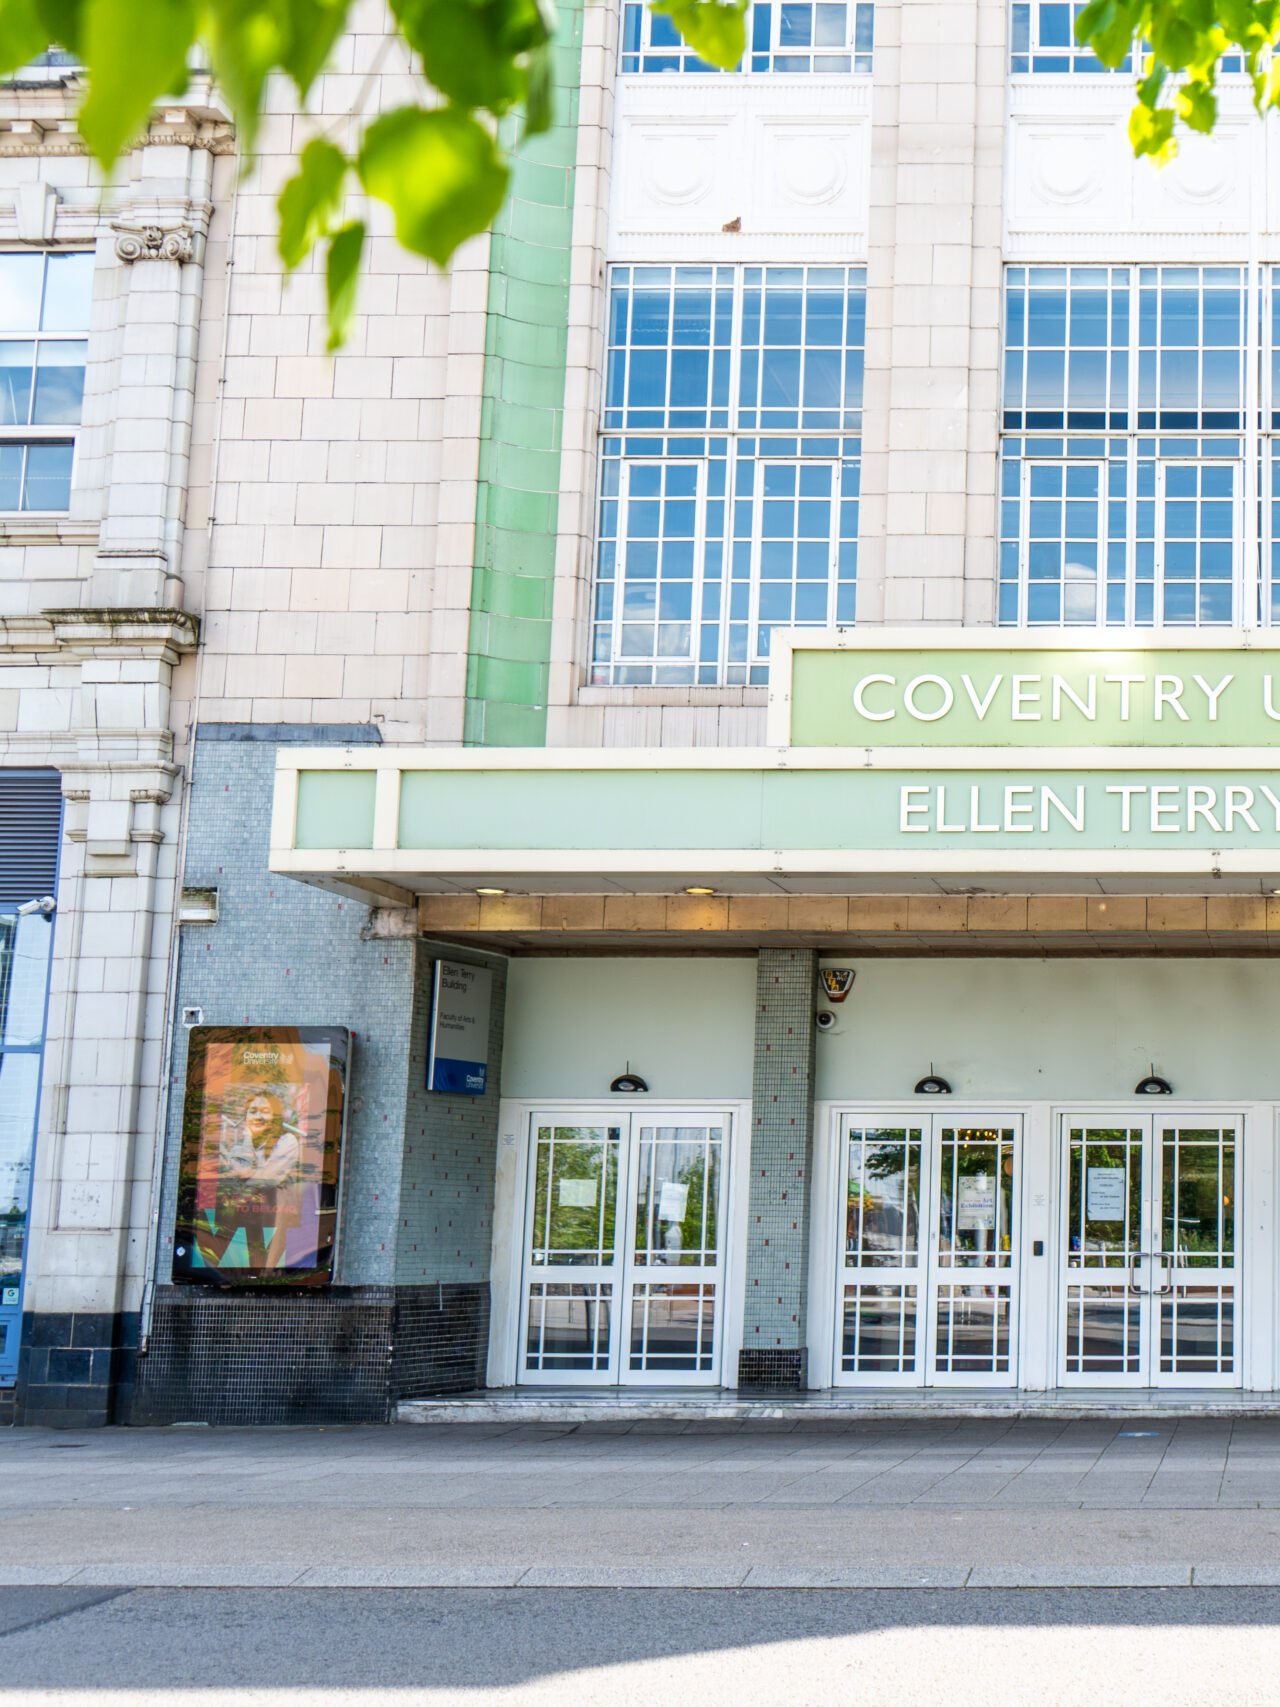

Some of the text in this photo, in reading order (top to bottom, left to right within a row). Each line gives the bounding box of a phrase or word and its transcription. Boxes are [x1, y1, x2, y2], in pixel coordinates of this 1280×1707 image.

[853, 673, 1235, 721] COVENTRY
[900, 785, 1085, 832] ELLEN
[442, 965, 475, 980] Ellen Terry
[441, 978, 467, 993] Building
[440, 1012, 457, 1023] Faculty
[243, 1051, 279, 1060] Coventry
[466, 1074, 484, 1085] Coventry
[236, 1205, 297, 1213] TO BELONG
